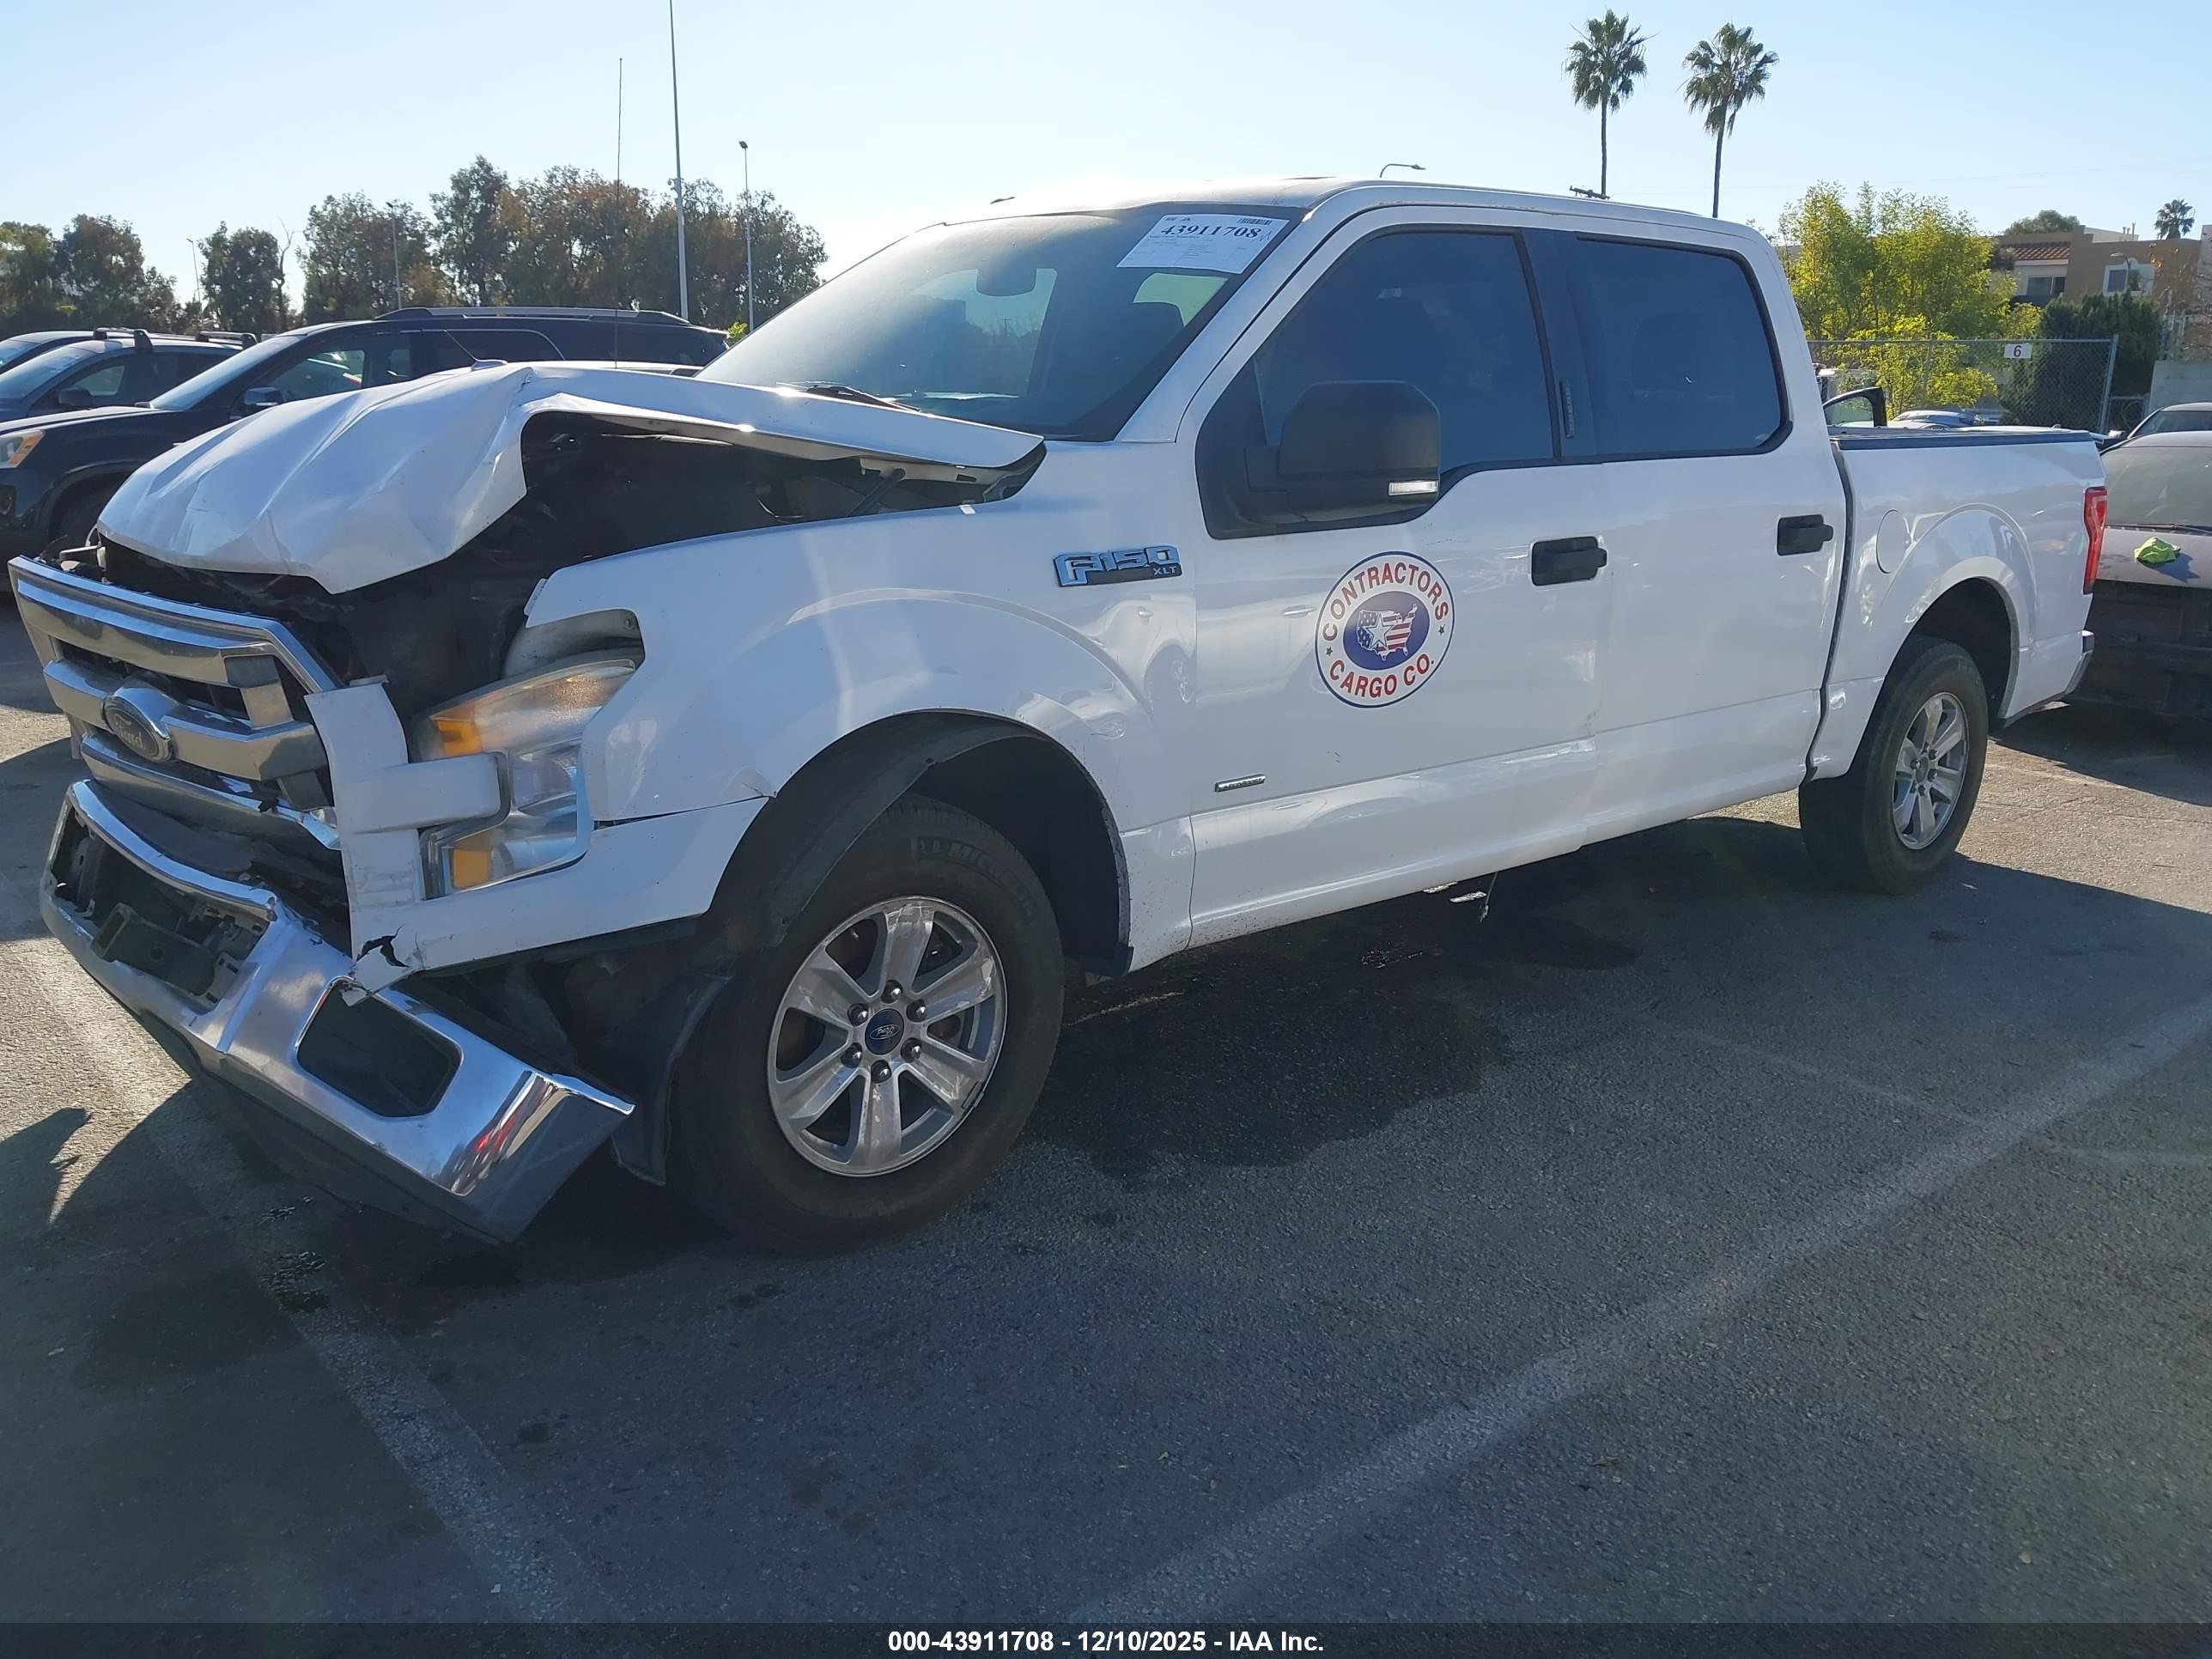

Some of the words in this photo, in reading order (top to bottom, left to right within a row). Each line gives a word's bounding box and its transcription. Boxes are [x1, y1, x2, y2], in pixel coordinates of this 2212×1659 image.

[1161, 225, 1261, 239] 43911708
[2013, 344, 2022, 357] 6
[1153, 566, 1177, 575] XLT
[1322, 562, 1449, 641] CONTRACTORS
[1329, 659, 1397, 698] CARGO
[1403, 653, 1435, 686] CO.
